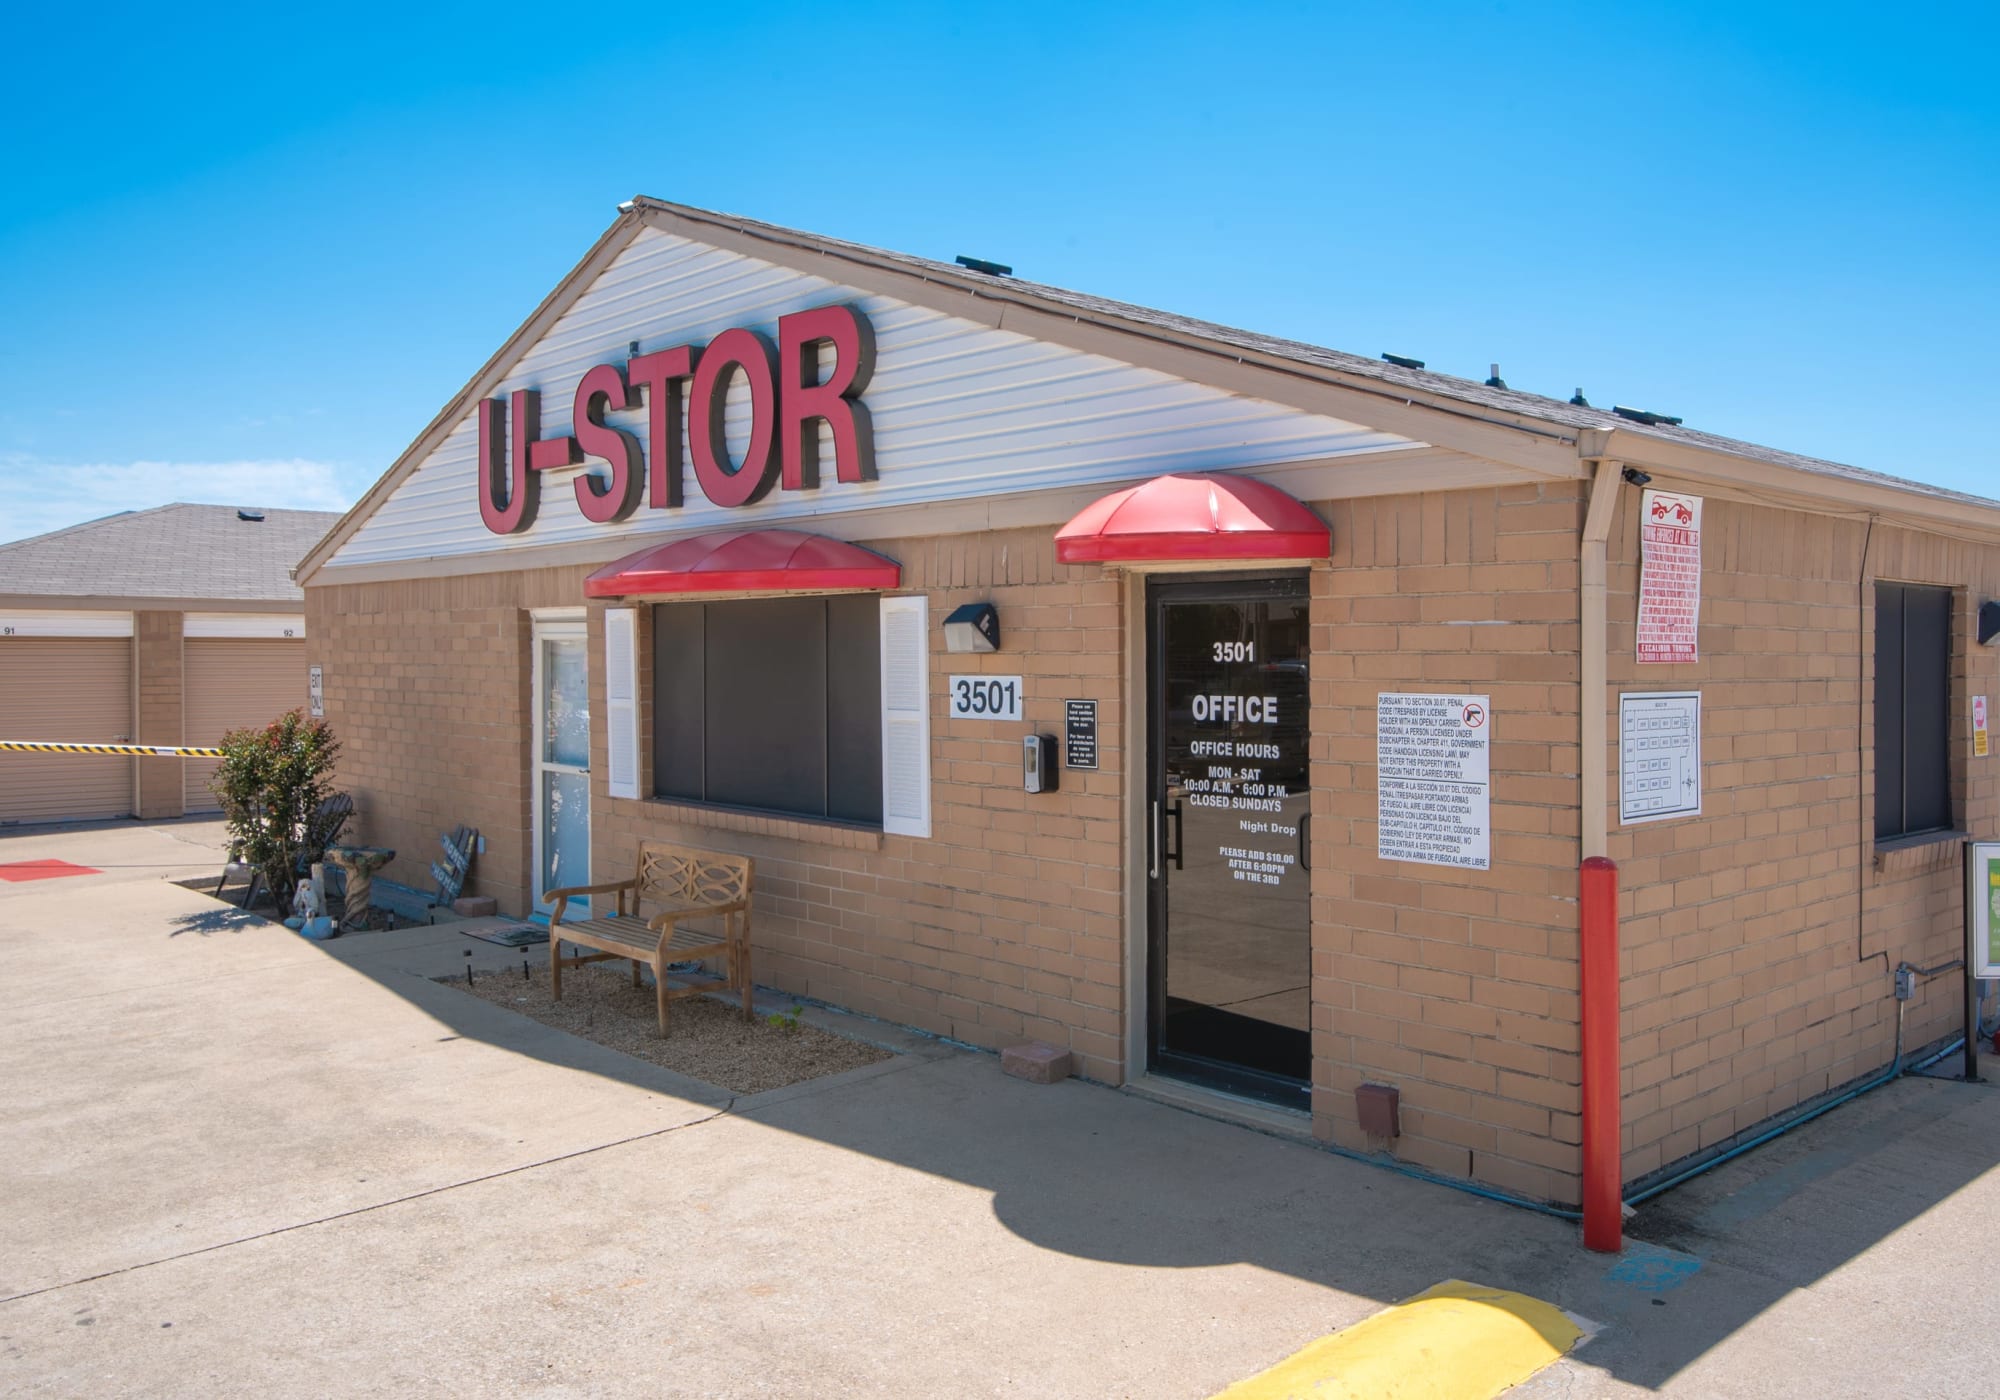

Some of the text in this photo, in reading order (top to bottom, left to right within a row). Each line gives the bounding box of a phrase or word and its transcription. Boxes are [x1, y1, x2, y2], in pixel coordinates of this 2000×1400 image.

[478, 304, 874, 535] U-STOR
[4, 627, 15, 635] 91
[283, 629, 294, 637] 92
[1213, 641, 1254, 662] 3501
[956, 680, 1015, 714] 3501
[1404, 697, 1410, 705] TO
[1412, 698, 1432, 706] SECTION
[1448, 698, 1464, 707] PENAL
[1192, 695, 1278, 723] OFFICE
[1379, 706, 1392, 715] CODE
[1420, 708, 1426, 716] BY
[1427, 708, 1448, 717] LICENSE
[1379, 716, 1461, 728] HOLDER WITH AN OPENLY CARRIED
[1410, 728, 1430, 736] PERSON
[1430, 728, 1454, 738] LICENSED
[1455, 730, 1472, 738] UNDER
[1190, 741, 1280, 759] OFFICE HOURS
[1417, 738, 1440, 747] CHAPTER
[1451, 740, 1485, 749] GOVERNMENT
[1379, 746, 1392, 754] CODE
[1419, 748, 1444, 758] LICENSING
[1460, 750, 1470, 759] MAY
[1379, 756, 1388, 764] NOT
[1390, 757, 1404, 766] ENTER
[1406, 758, 1416, 766] THIS
[1418, 758, 1442, 768] PROPERTY
[1444, 760, 1456, 768] WITH
[1208, 766, 1232, 779] MON
[1240, 768, 1261, 781] SAT
[1379, 766, 1402, 775] HANDGUN
[1402, 767, 1415, 776] THAT
[1416, 768, 1421, 776] IS
[1422, 769, 1443, 778] CARRIED
[1184, 779, 1210, 792] 10:00
[1212, 782, 1234, 793] A.M.
[1243, 784, 1264, 796] 6:00
[1268, 786, 1288, 798] P.M.
[1190, 794, 1282, 812] CLOSED SUNDAYS
[1240, 820, 1296, 837] Night Drop
[1220, 846, 1294, 864] PLEASE ADD $10.00
[1229, 859, 1284, 875] AFTER 6:00PM
[1234, 870, 1280, 885] ON THE 3RD
